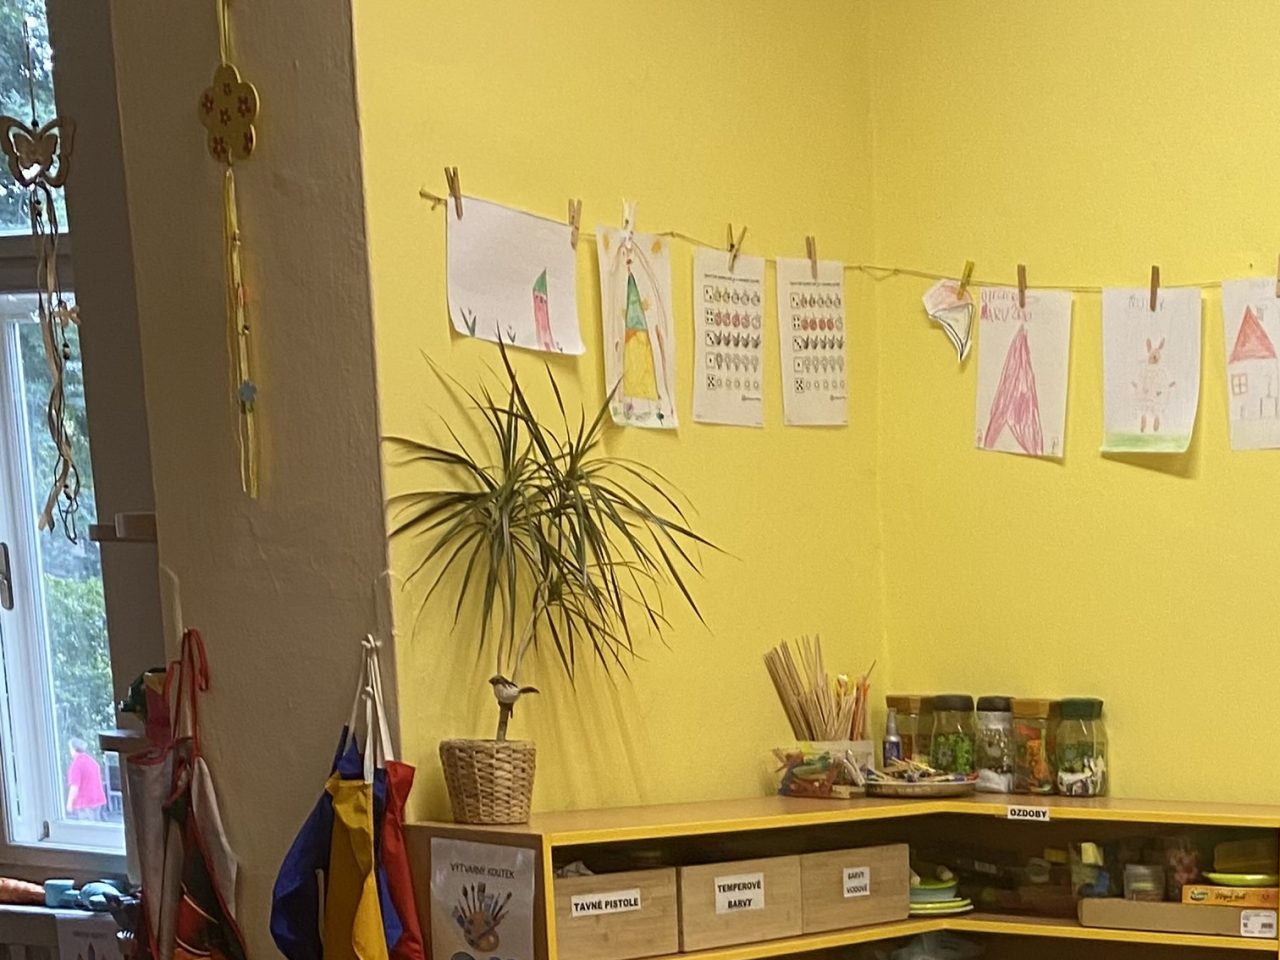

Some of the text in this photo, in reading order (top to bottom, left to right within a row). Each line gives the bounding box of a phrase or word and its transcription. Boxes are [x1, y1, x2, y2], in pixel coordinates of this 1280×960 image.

[1010, 808, 1047, 818] OZDOBY
[717, 879, 761, 893] TEMPEROVÉ
[574, 897, 639, 912] TAVNÉ PISTOLE
[727, 898, 752, 909] BARVY
